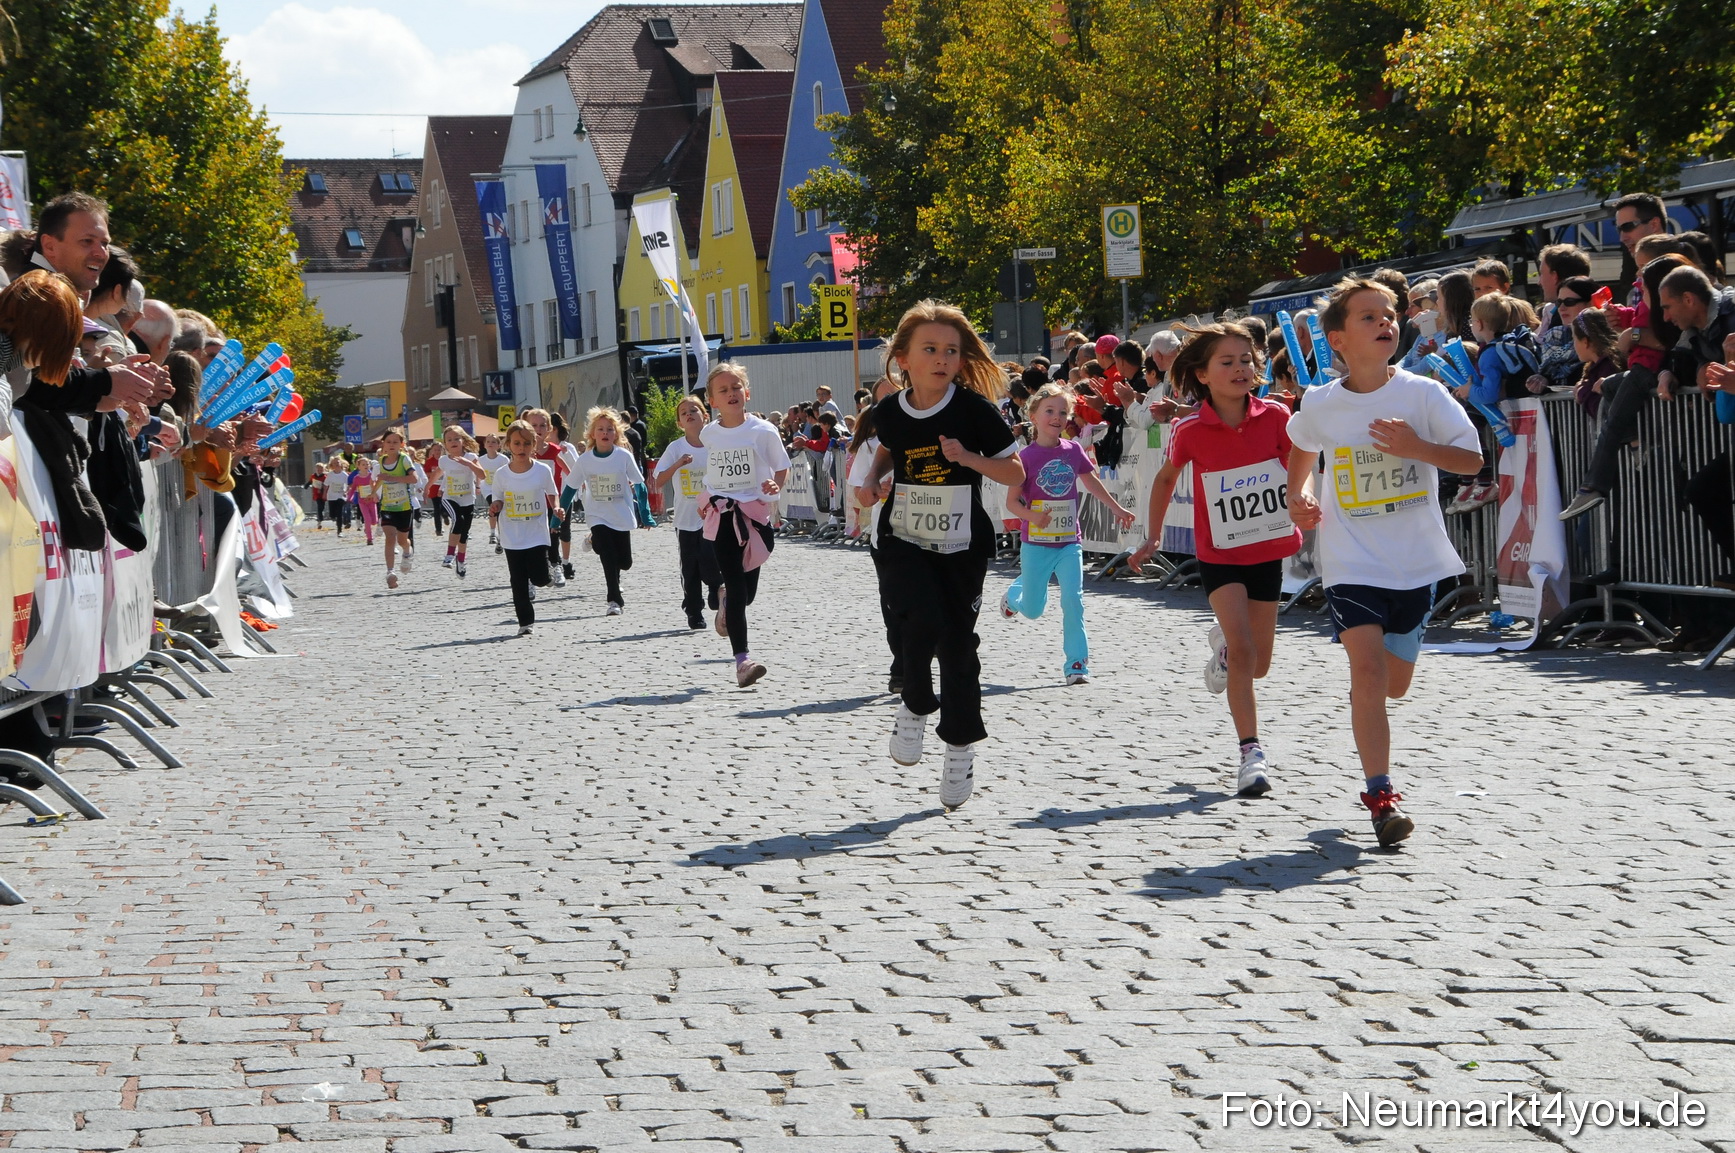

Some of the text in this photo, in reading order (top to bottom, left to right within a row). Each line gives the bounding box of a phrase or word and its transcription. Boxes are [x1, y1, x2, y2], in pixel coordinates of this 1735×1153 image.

[1114, 215, 1128, 231] H
[1020, 249, 1054, 258] Ulmer Gasse
[556, 230, 579, 317] K&L RUPPERT
[824, 287, 852, 297] Block
[830, 301, 848, 328] B
[1453, 354, 1469, 381] www.
[203, 365, 258, 419] ww.maxi-dsl.de
[502, 413, 512, 427] C
[905, 445, 939, 455] NEUMARKTER
[907, 451, 936, 459] STADTLAUF
[1355, 450, 1383, 465] Elisa
[710, 449, 749, 467] SARAH
[719, 463, 751, 478] 7309
[1036, 465, 1076, 488] Fever
[1220, 473, 1270, 493] Lena
[1337, 474, 1349, 485] K3
[1360, 464, 1419, 493] 7154
[600, 483, 622, 493] 7188
[910, 491, 942, 505] Selina
[1213, 483, 1288, 523] 10206
[1395, 495, 1429, 509] PFLEIDERER
[515, 501, 540, 512] 7110
[892, 510, 903, 520] K3
[911, 512, 964, 531] 7087
